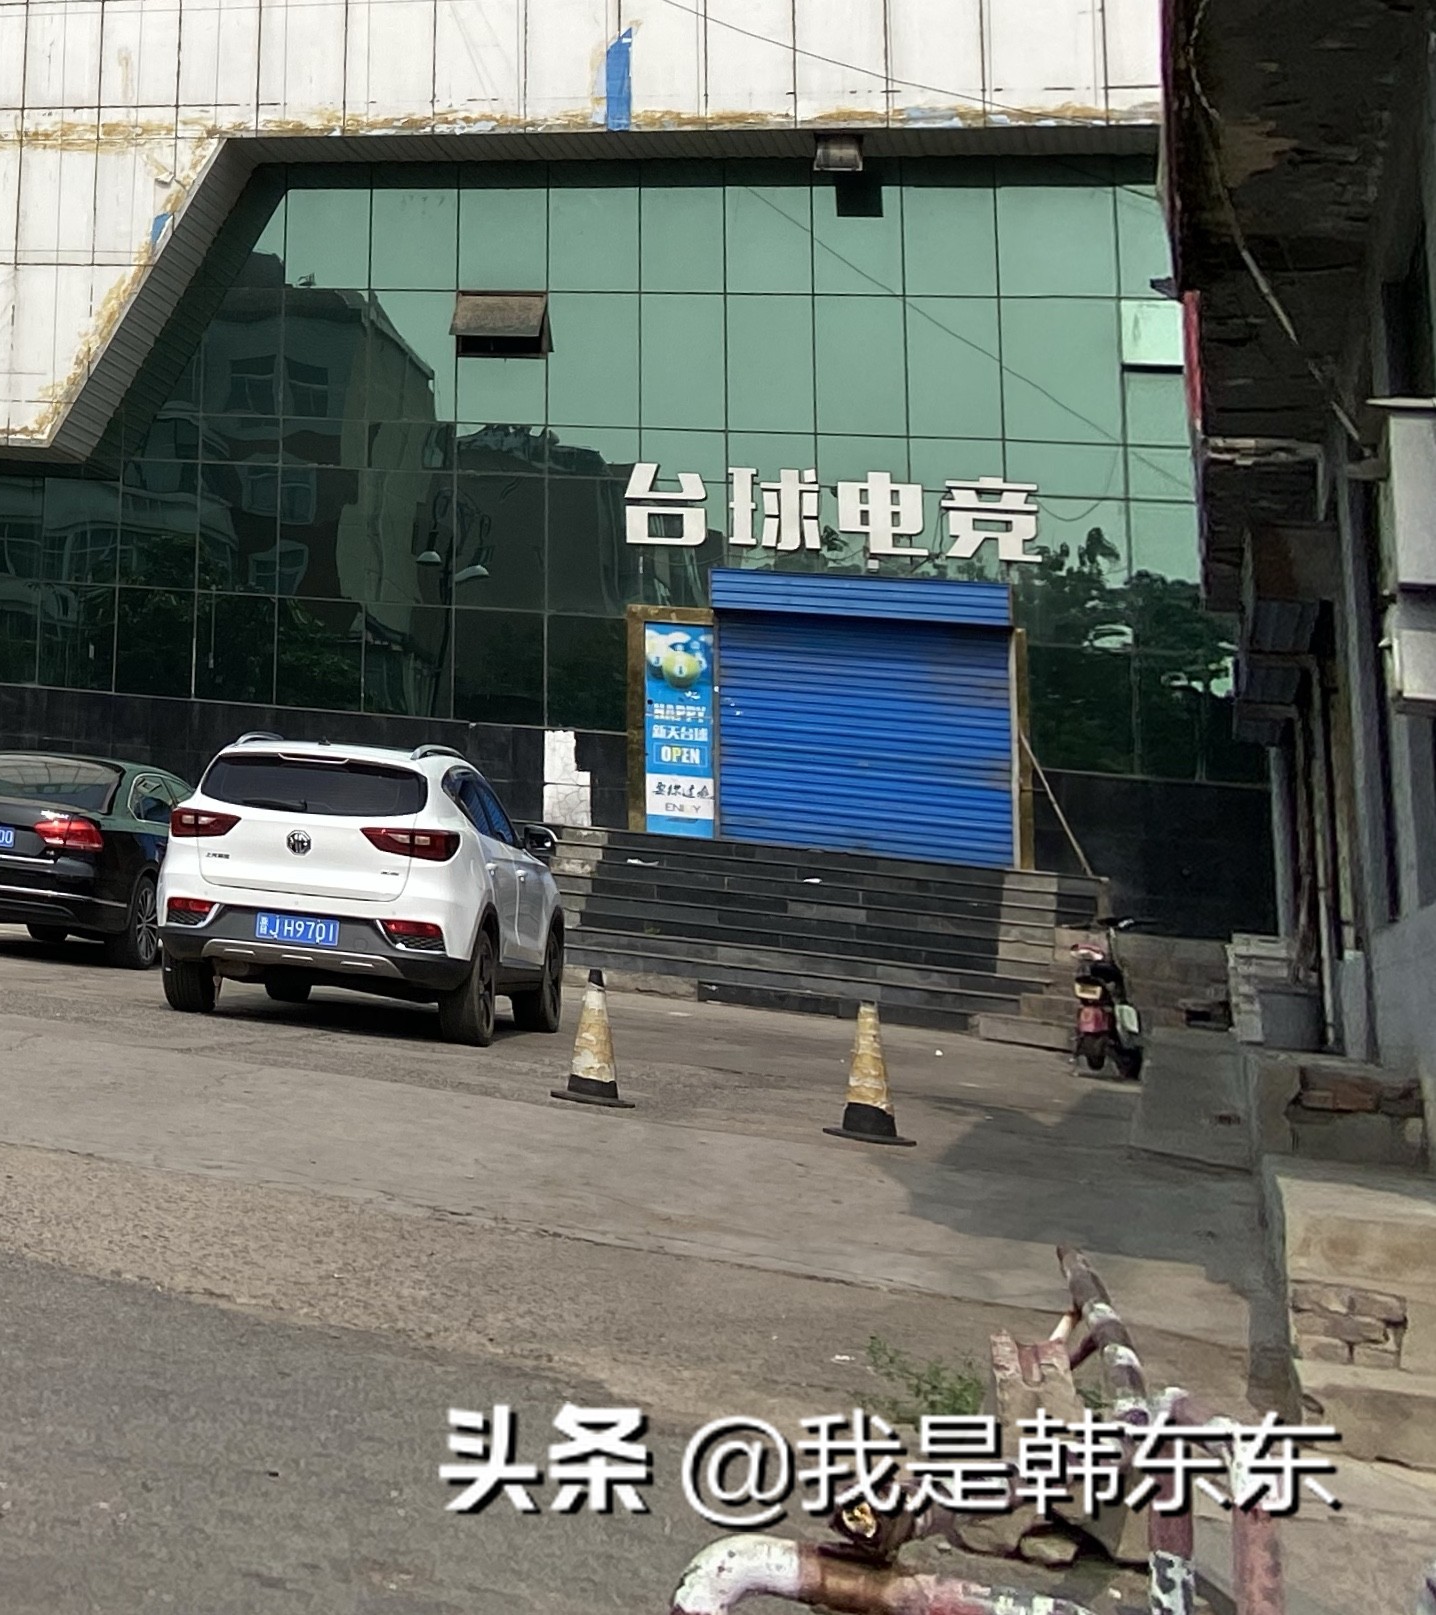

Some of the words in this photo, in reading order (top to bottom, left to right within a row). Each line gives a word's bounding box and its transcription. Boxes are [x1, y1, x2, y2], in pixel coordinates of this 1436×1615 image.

[624, 462, 1043, 564] 台球电竞
[651, 724, 709, 742] 新天台球
[660, 746, 701, 765] OPEN
